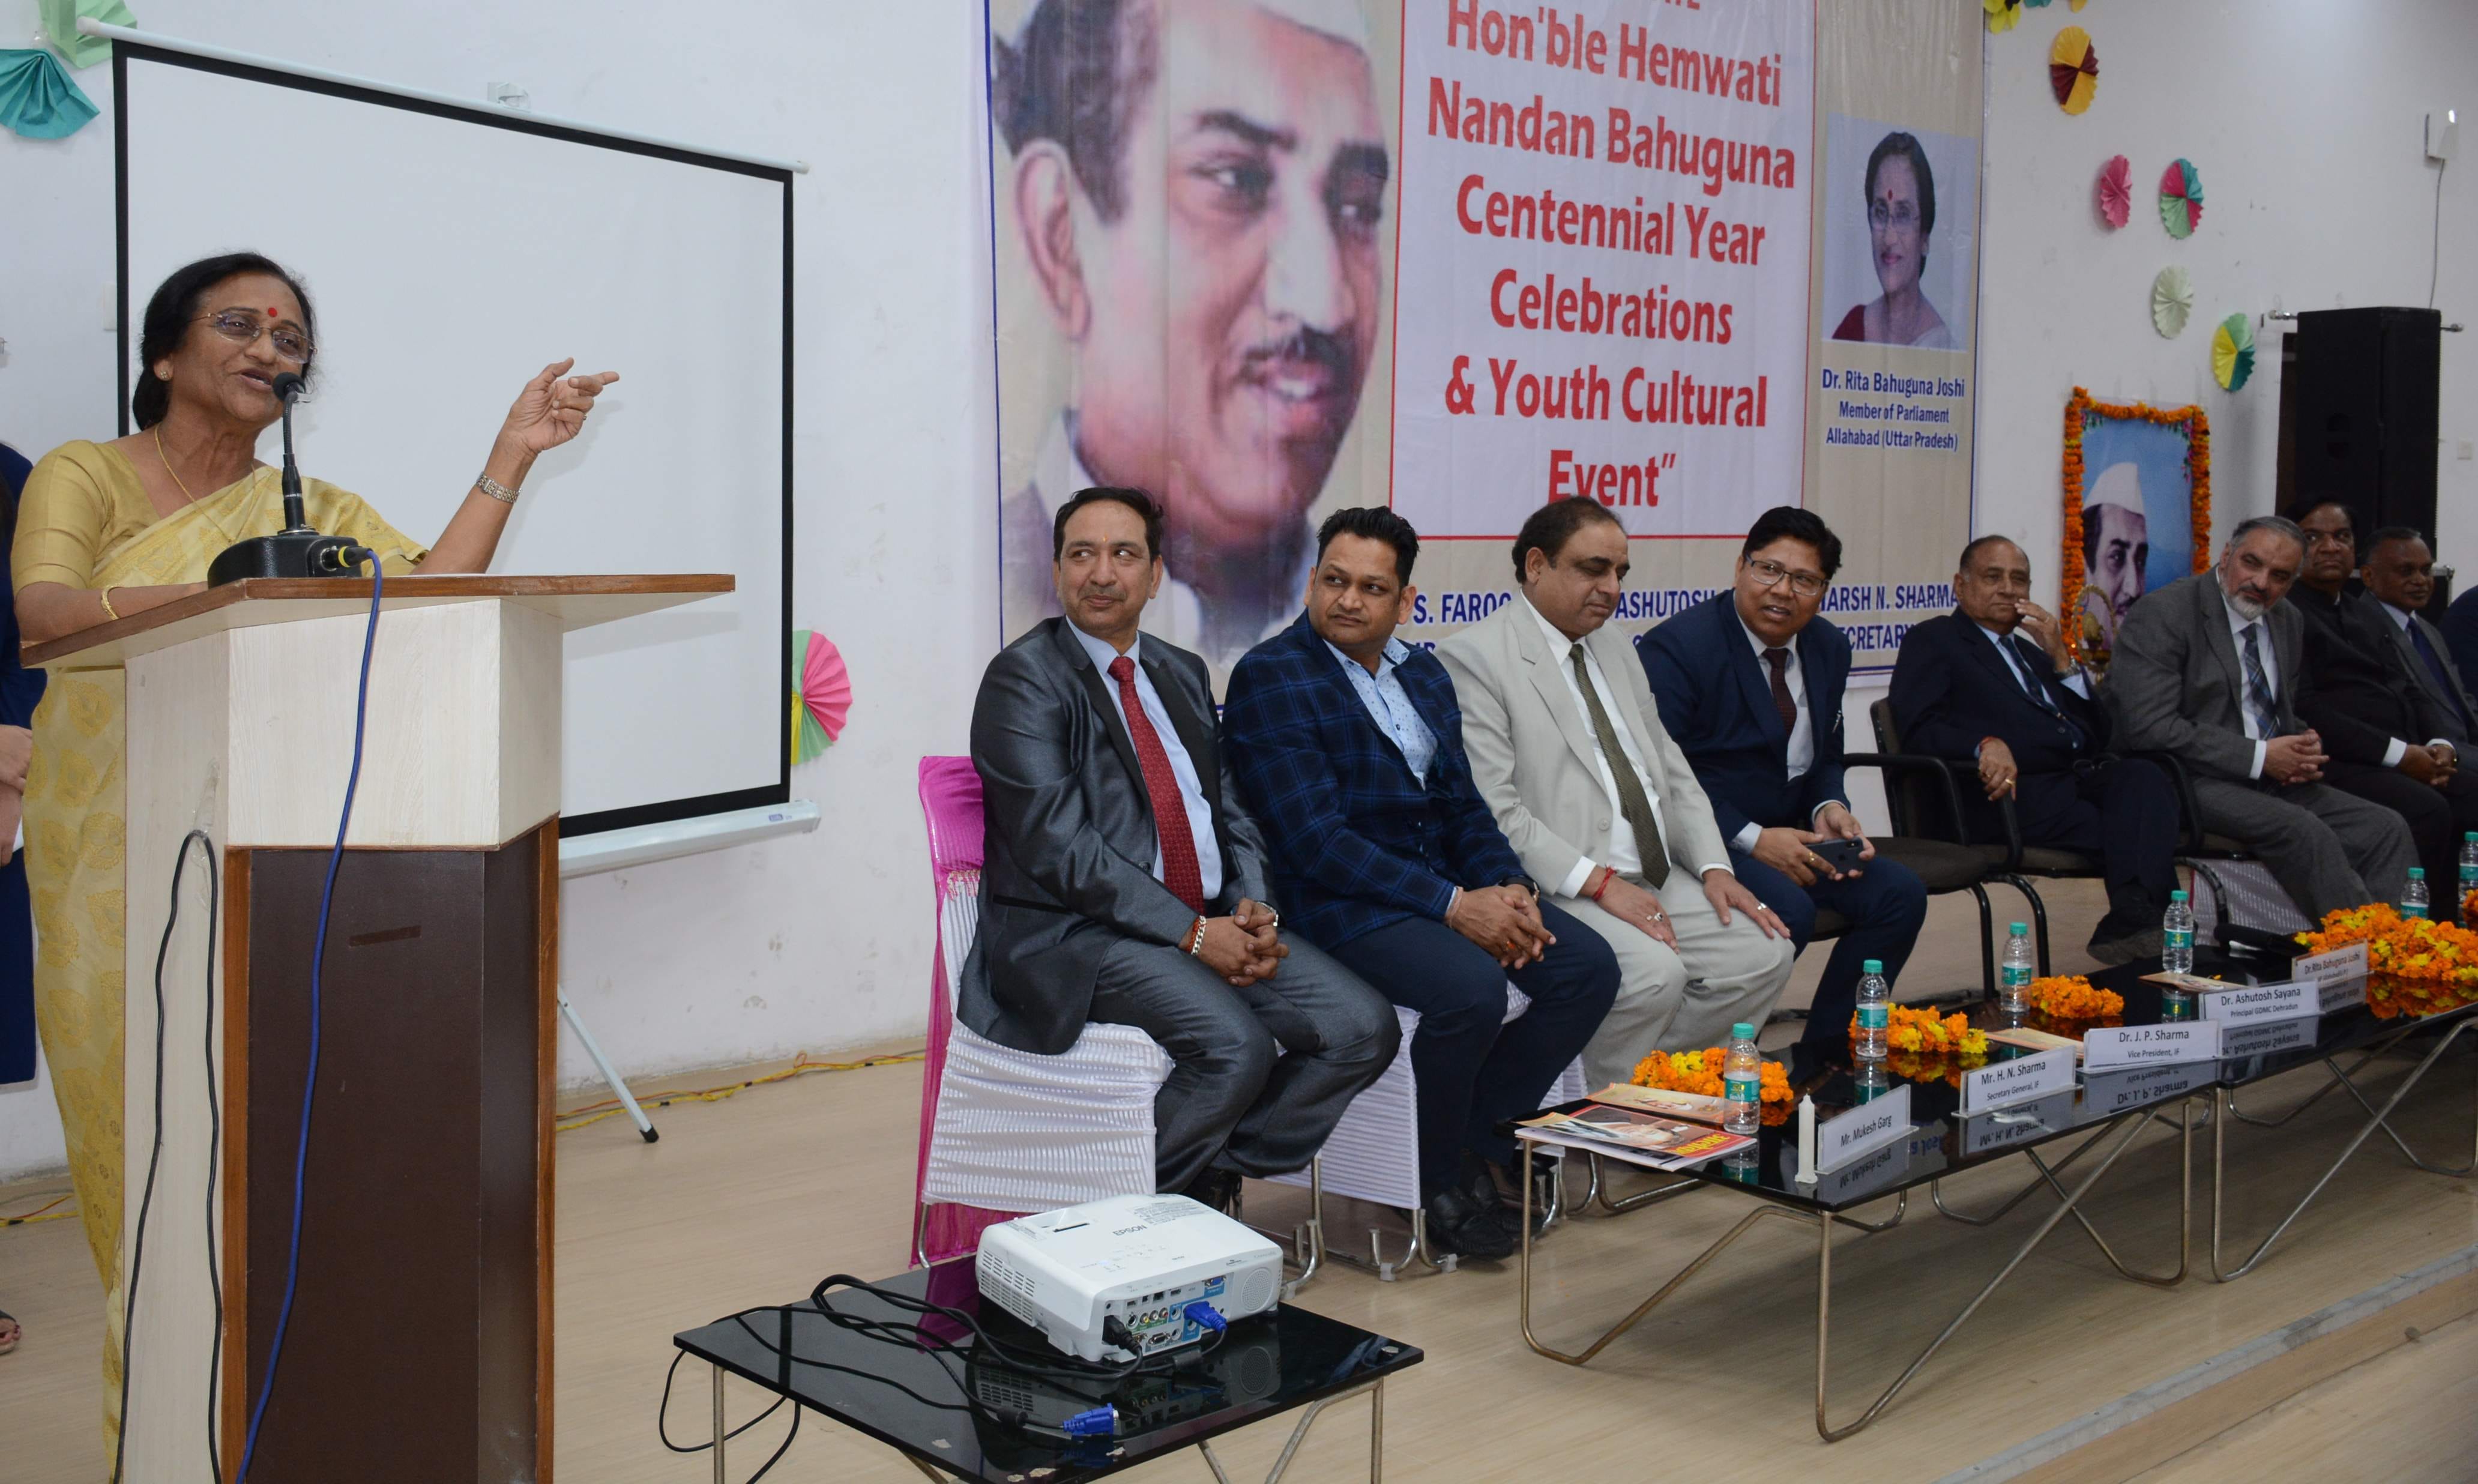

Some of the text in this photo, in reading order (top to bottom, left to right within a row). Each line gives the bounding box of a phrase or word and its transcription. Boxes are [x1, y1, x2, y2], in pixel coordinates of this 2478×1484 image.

[1447, 0, 1781, 107] Hon'ble Hemwati
[1428, 76, 1795, 197] Nandan Bahuguna
[1457, 174, 1765, 266] Centennial Year
[1491, 268, 1733, 345] Celebrations
[1445, 355, 1767, 427] & Youth Cultural
[1822, 369, 1965, 399] Dr. Rita Bahuguna Joshi
[1839, 401, 1949, 423] Member of Parliament
[1826, 427, 1958, 452] Allahabad (Uttar Pradesh)
[1413, 594, 1433, 624] S.
[1876, 586, 1890, 610] N.
[2221, 988, 2301, 1006] Dr. Ashutosh Sayana
[2231, 1003, 2299, 1018] Principal GDMC Dehradun
[2119, 1030, 2189, 1043] Dr. J. P. Sharma
[2127, 1050, 2141, 1058] Vice
[2142, 1049, 2172, 1058] President,
[1981, 1061, 2046, 1085] Mr. H. N. Sharma
[1987, 1087, 2010, 1101] Secretary
[1840, 1115, 1892, 1147] Mr. Mukesh Garg
[1112, 1224, 1148, 1237] EPSON
